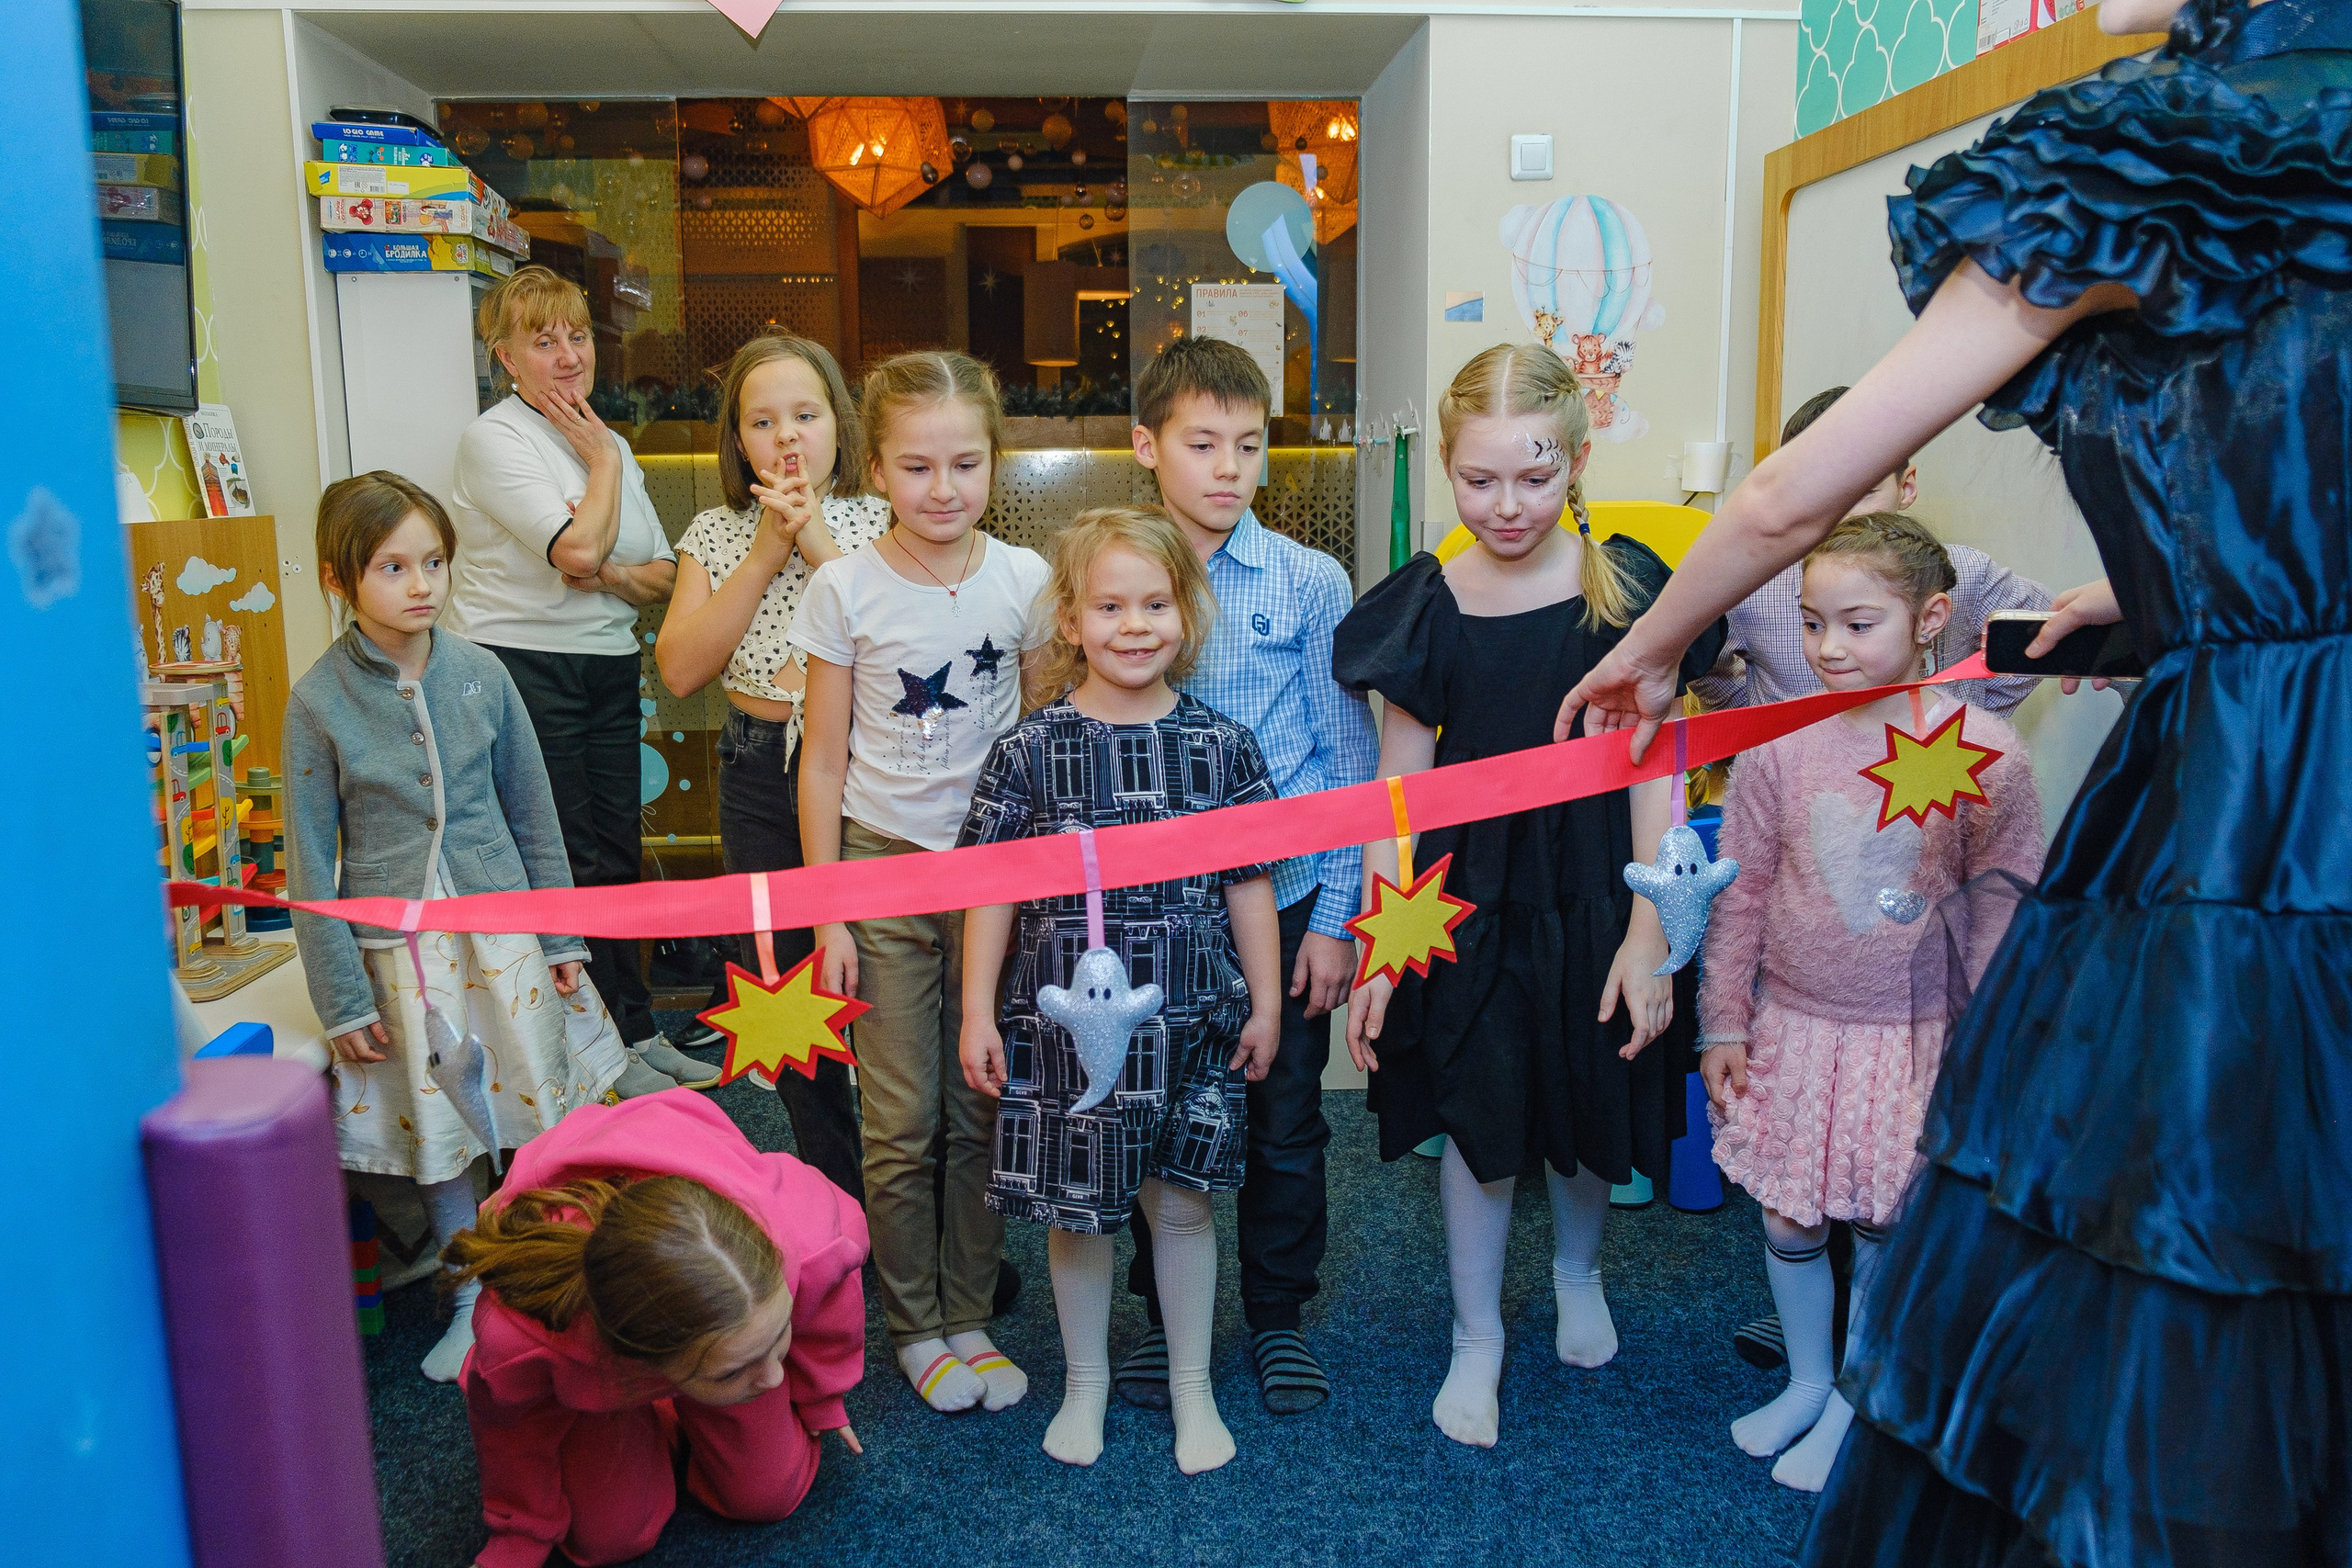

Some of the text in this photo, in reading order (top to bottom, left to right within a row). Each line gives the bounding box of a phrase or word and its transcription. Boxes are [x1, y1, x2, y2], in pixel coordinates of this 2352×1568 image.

[385, 249, 427, 259] БРОДИЛКА
[1196, 289, 1238, 298] ПРАВИЛА
[198, 442, 237, 452] И МИНЕРАЛЫ
[940, 749, 950, 770] follow
